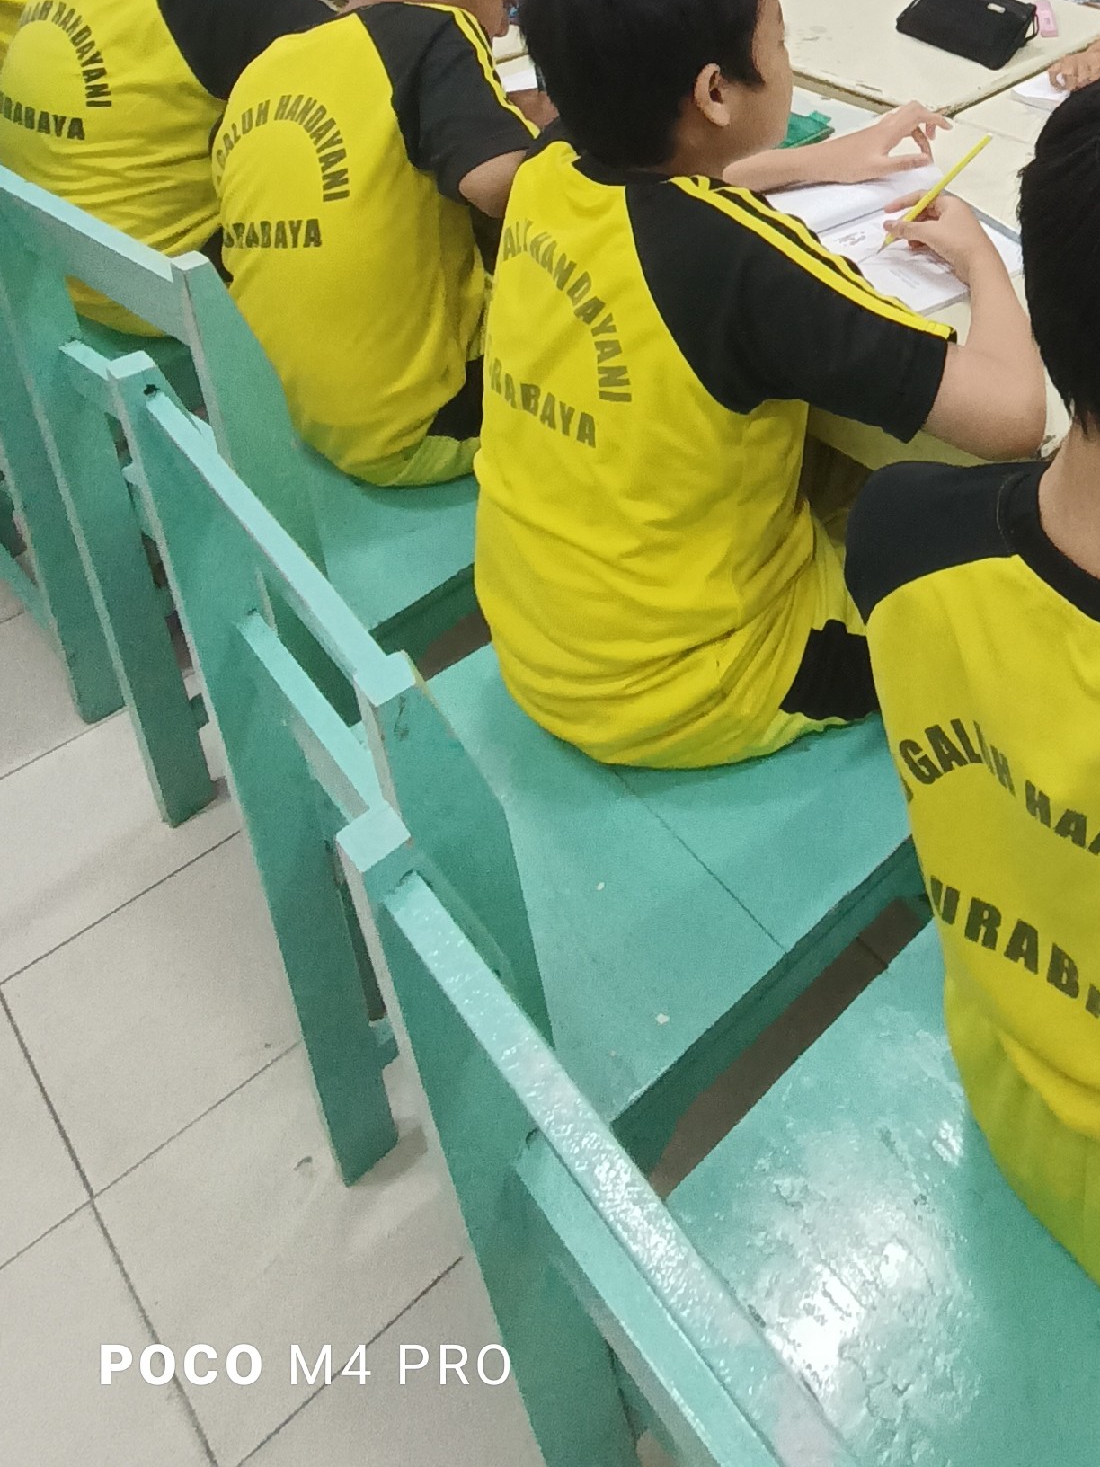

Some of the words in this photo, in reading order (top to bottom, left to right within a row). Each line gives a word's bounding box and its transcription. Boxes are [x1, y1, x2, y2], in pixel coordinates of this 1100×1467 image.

[274, 94, 350, 203] HANDAYANI
[529, 230, 633, 403] HANDAYANI
[489, 357, 597, 449] RABAYA
